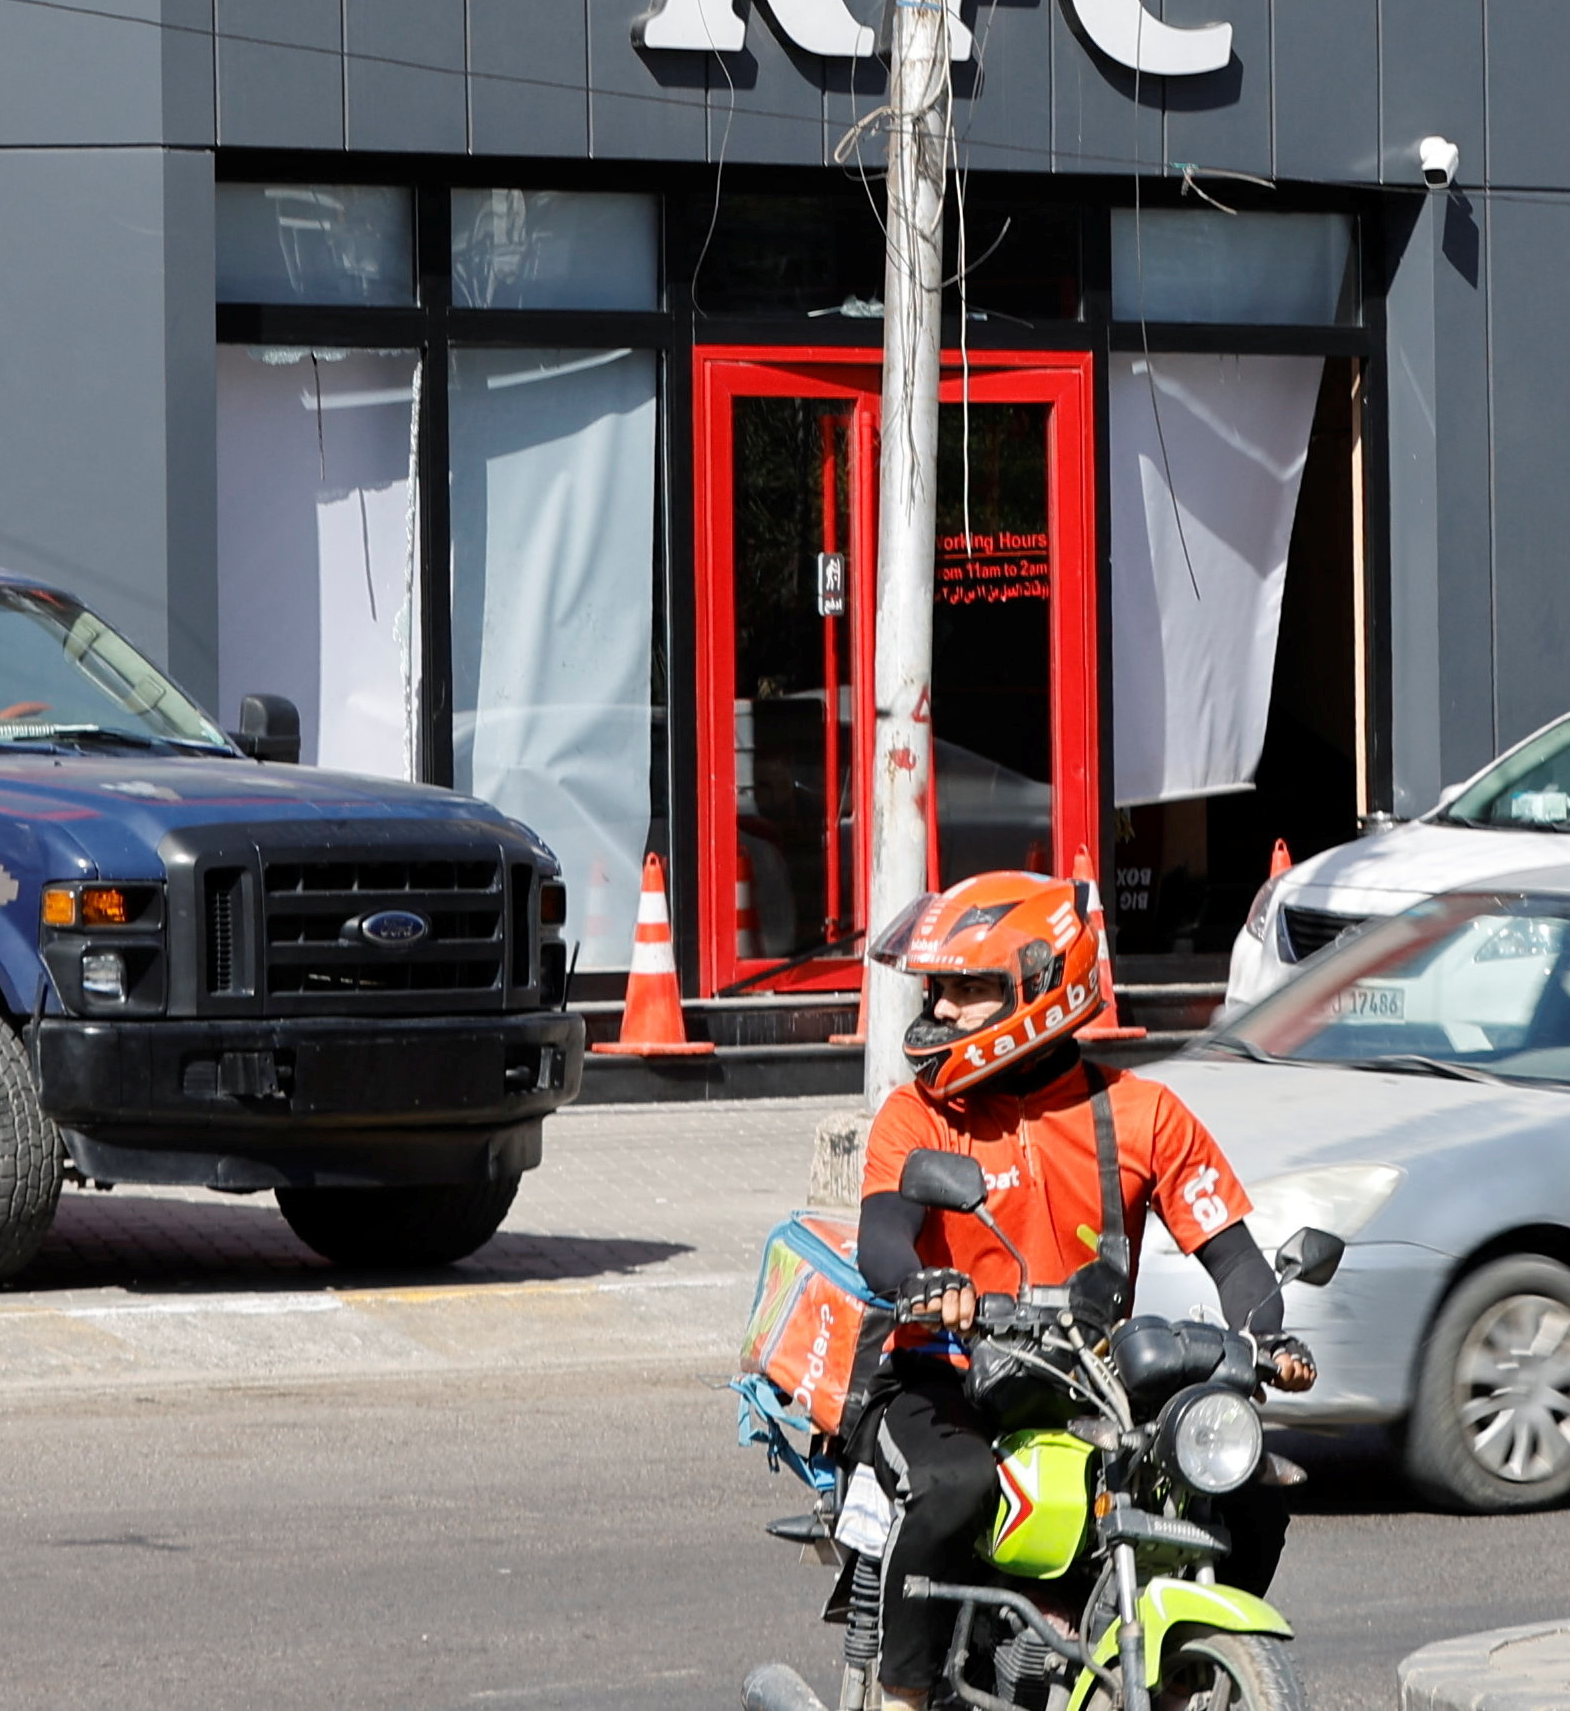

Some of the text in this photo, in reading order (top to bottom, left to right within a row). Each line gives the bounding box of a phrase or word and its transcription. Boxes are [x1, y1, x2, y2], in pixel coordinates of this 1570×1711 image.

[999, 530, 1047, 548] Hours
[937, 559, 1048, 581] rom 11am to 2am
[1116, 867, 1152, 887] BOX
[1119, 891, 1149, 910] BIG
[1350, 991, 1399, 1016] 17486
